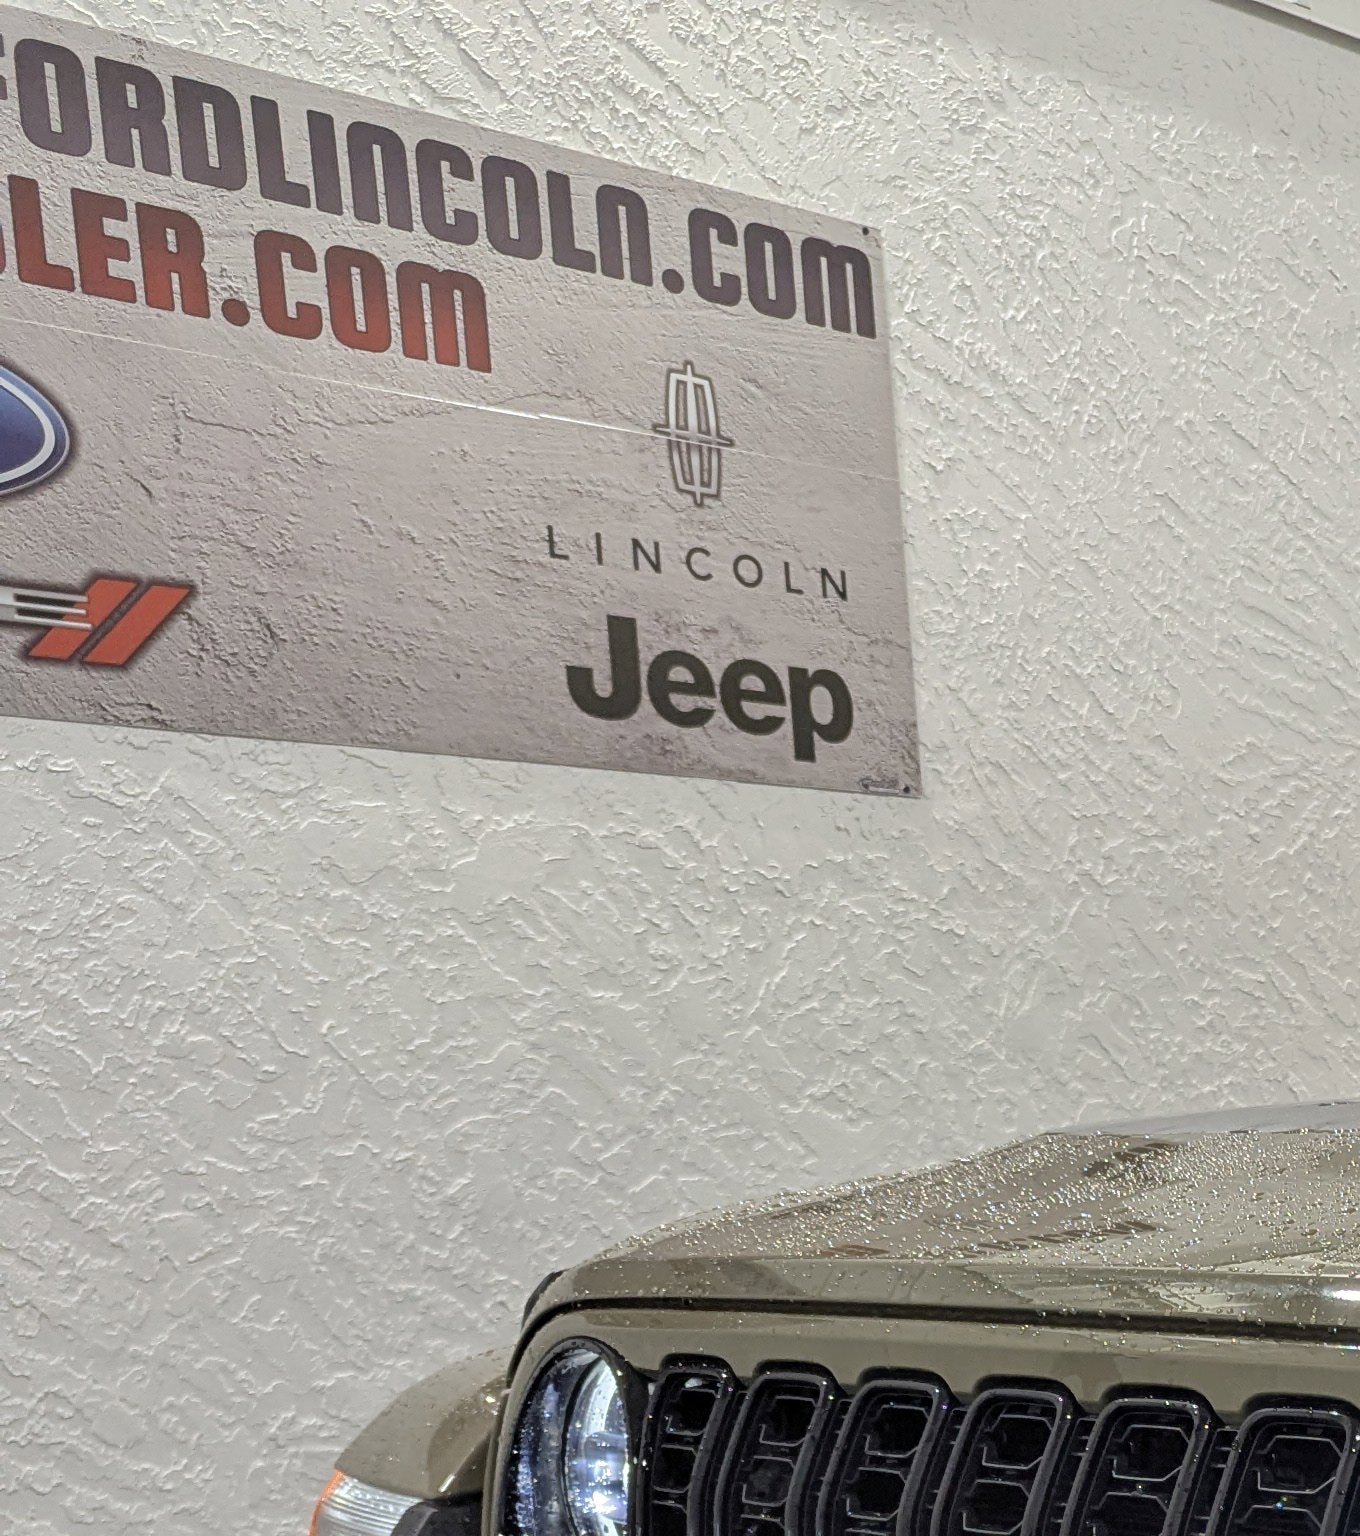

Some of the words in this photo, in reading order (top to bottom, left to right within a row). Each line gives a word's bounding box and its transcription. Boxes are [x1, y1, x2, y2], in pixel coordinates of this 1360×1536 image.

[0, 33, 878, 340] ORDLINCOLN.COM
[0, 174, 493, 373] LER.COM
[546, 525, 849, 601] LINCOLN
[566, 614, 854, 763] Jeep
